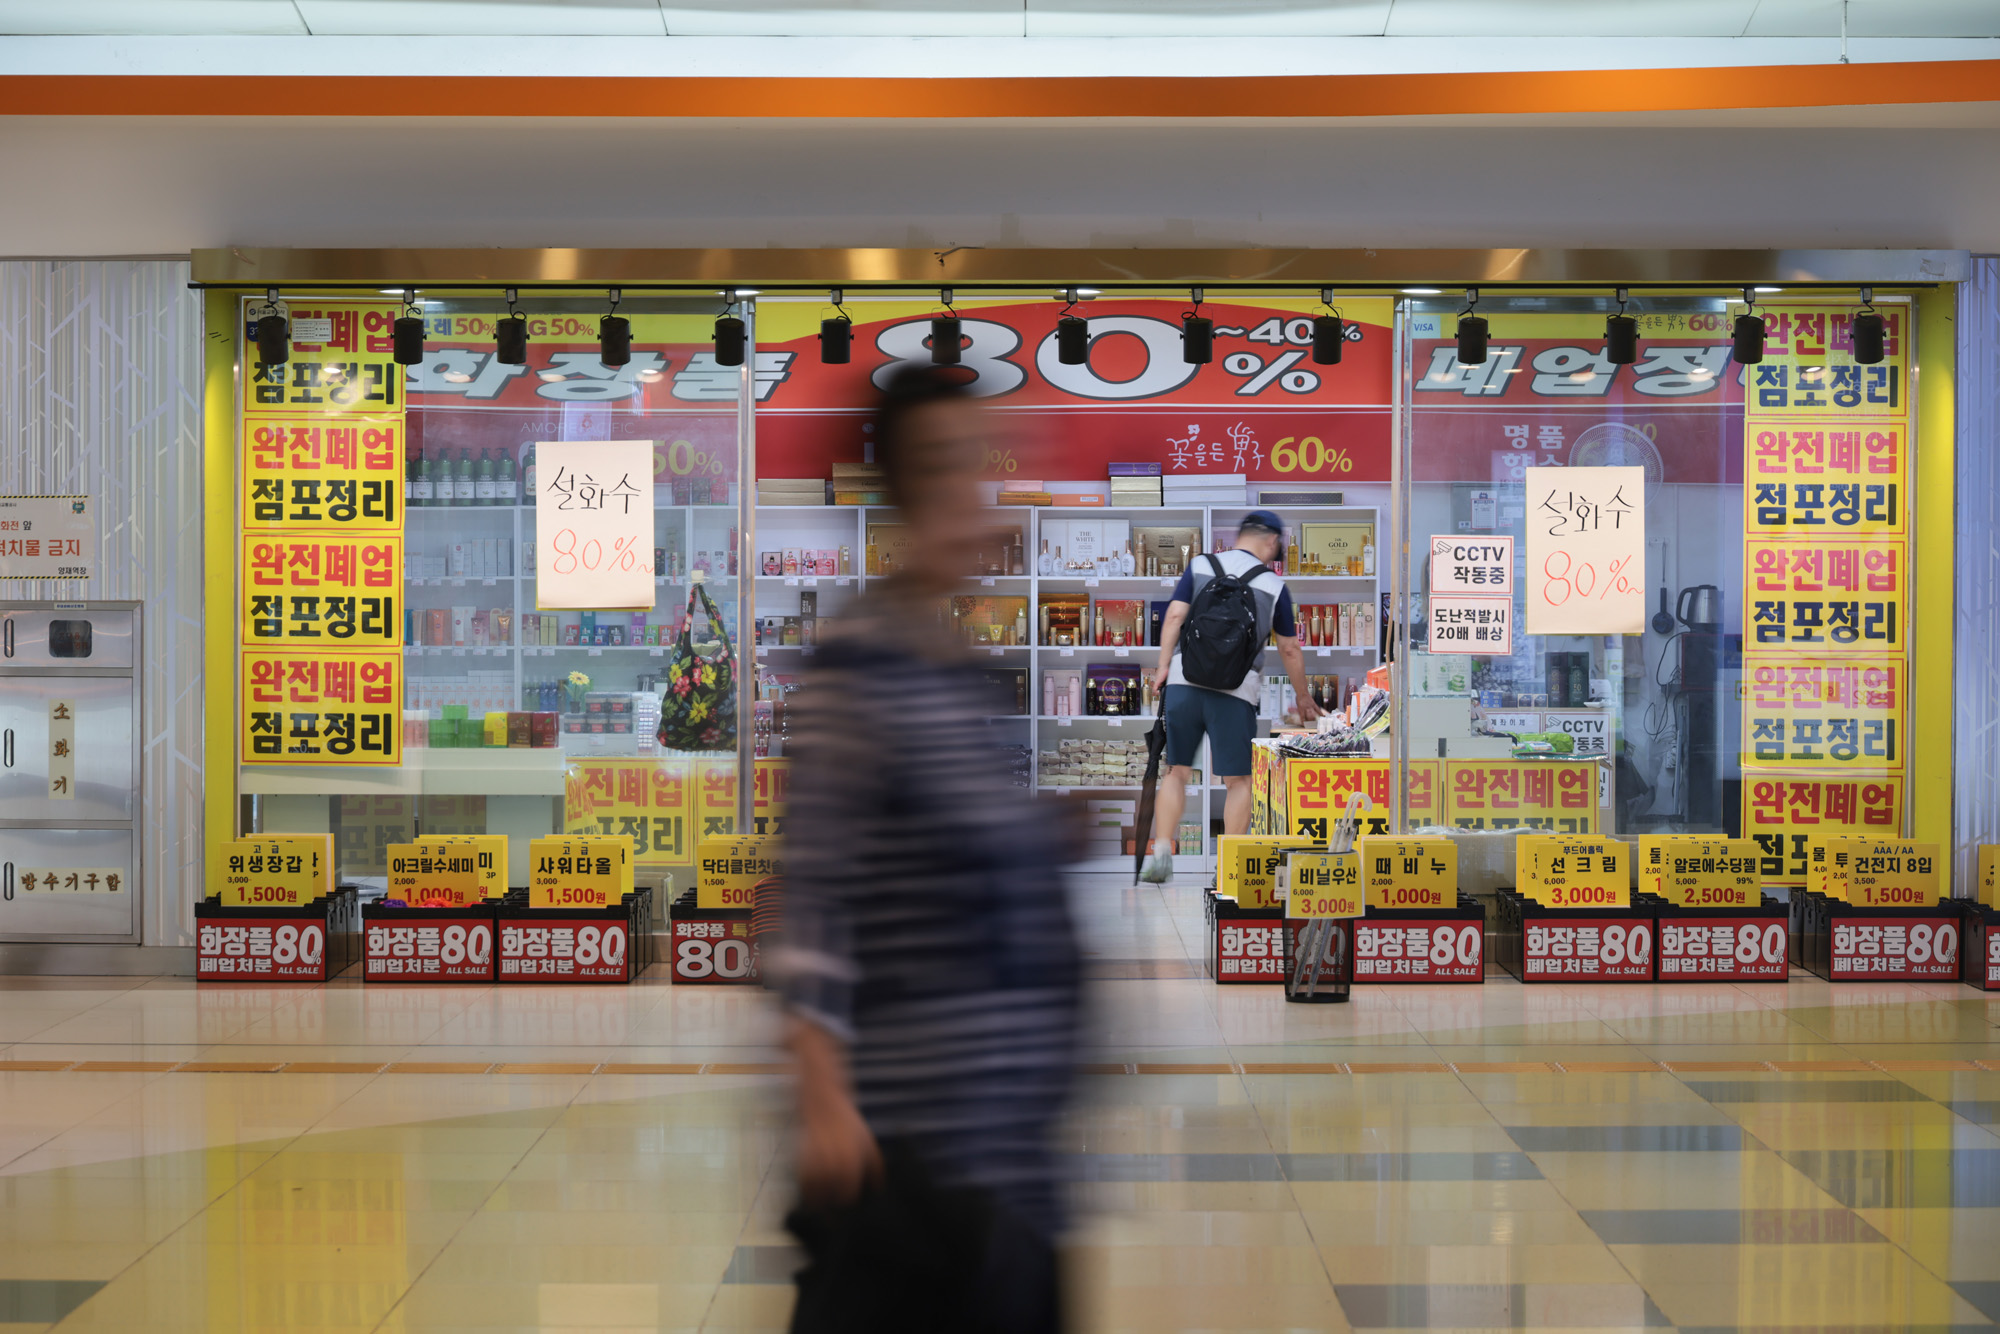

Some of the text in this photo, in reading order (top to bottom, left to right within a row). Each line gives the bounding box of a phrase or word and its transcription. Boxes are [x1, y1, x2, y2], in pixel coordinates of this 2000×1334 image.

[550, 318, 594, 336] 50%
[1413, 323, 1434, 333] VISA
[1688, 314, 1733, 332] 60%
[252, 361, 395, 404] 점포정리
[1756, 365, 1899, 408] 점포정리
[250, 427, 395, 471] 완전폐업
[1271, 436, 1353, 473] 60%
[1755, 431, 1898, 474] 완전폐업
[547, 465, 643, 514] 설화수
[251, 478, 394, 522] 점포정리
[1754, 484, 1897, 526] 점포정리
[1537, 485, 1636, 537] 설화수
[48, 539, 81, 557] 금지
[1453, 546, 1505, 562] CCTV
[251, 543, 393, 587] 완전폐업
[1754, 549, 1896, 592] 완전폐업
[1453, 566, 1505, 584] 작동중
[251, 595, 393, 639] 점포정리
[1435, 608, 1505, 624] 도난적발시
[1753, 601, 1895, 643] 점포정리
[1436, 626, 1504, 642] 20배 배상
[250, 660, 392, 704] 완전폐업
[1753, 666, 1895, 709] 완전폐업
[250, 712, 392, 755] 점포정리
[1562, 721, 1604, 733] CCTV
[1574, 737, 1604, 750] 동중
[1752, 718, 1895, 760] 점포정리
[1454, 768, 1589, 808] 완전폐업
[1752, 782, 1894, 825] 완전폐업
[1873, 846, 1892, 854] AAA
[1901, 846, 1914, 854] AA
[229, 855, 302, 873] 위생장갑
[393, 857, 474, 874] 아크릴수세미
[537, 856, 612, 875] 샤워타올
[1675, 857, 1756, 873] 알로에수딩젤
[1855, 857, 1932, 874] 건전지 8입
[227, 876, 249, 884] 3,000
[1299, 867, 1357, 886] 비닐우산
[1544, 877, 1566, 885] 6,000
[1736, 877, 1754, 885] 99%
[1854, 877, 1876, 885] 3,500
[237, 886, 297, 903] 1,500원
[404, 887, 464, 903] 1,000원
[546, 888, 606, 906] 1,500원
[1293, 889, 1314, 897] 6,000
[1381, 888, 1441, 906] 1,000원
[1551, 887, 1616, 906] 3,000원
[1684, 887, 1746, 906] 2,500원
[1864, 887, 1924, 905] 1,500원
[1301, 898, 1355, 915] 3,000원
[676, 922, 726, 938] 화장품
[200, 925, 273, 956] 화장품
[367, 926, 440, 957] 화장품
[501, 926, 574, 957] 화장품
[1356, 926, 1430, 957] 화장품
[1526, 925, 1600, 956] 화장품
[1661, 925, 1735, 956] 화장품
[1833, 924, 1907, 955] 화장품
[200, 957, 319, 975] 폐업처분 ALL SALE
[367, 958, 488, 975] 폐업처분 ALL SALE
[501, 959, 621, 976] 폐업처분 ALL SALE
[1356, 959, 1476, 976] 폐업처분 ALL SALE
[1526, 958, 1647, 975] 폐업처분 ALL SALE
[1661, 957, 1782, 974] 폐업처분 ALL SALE
[1833, 956, 1953, 974] 폐업처분 ALL SALE
